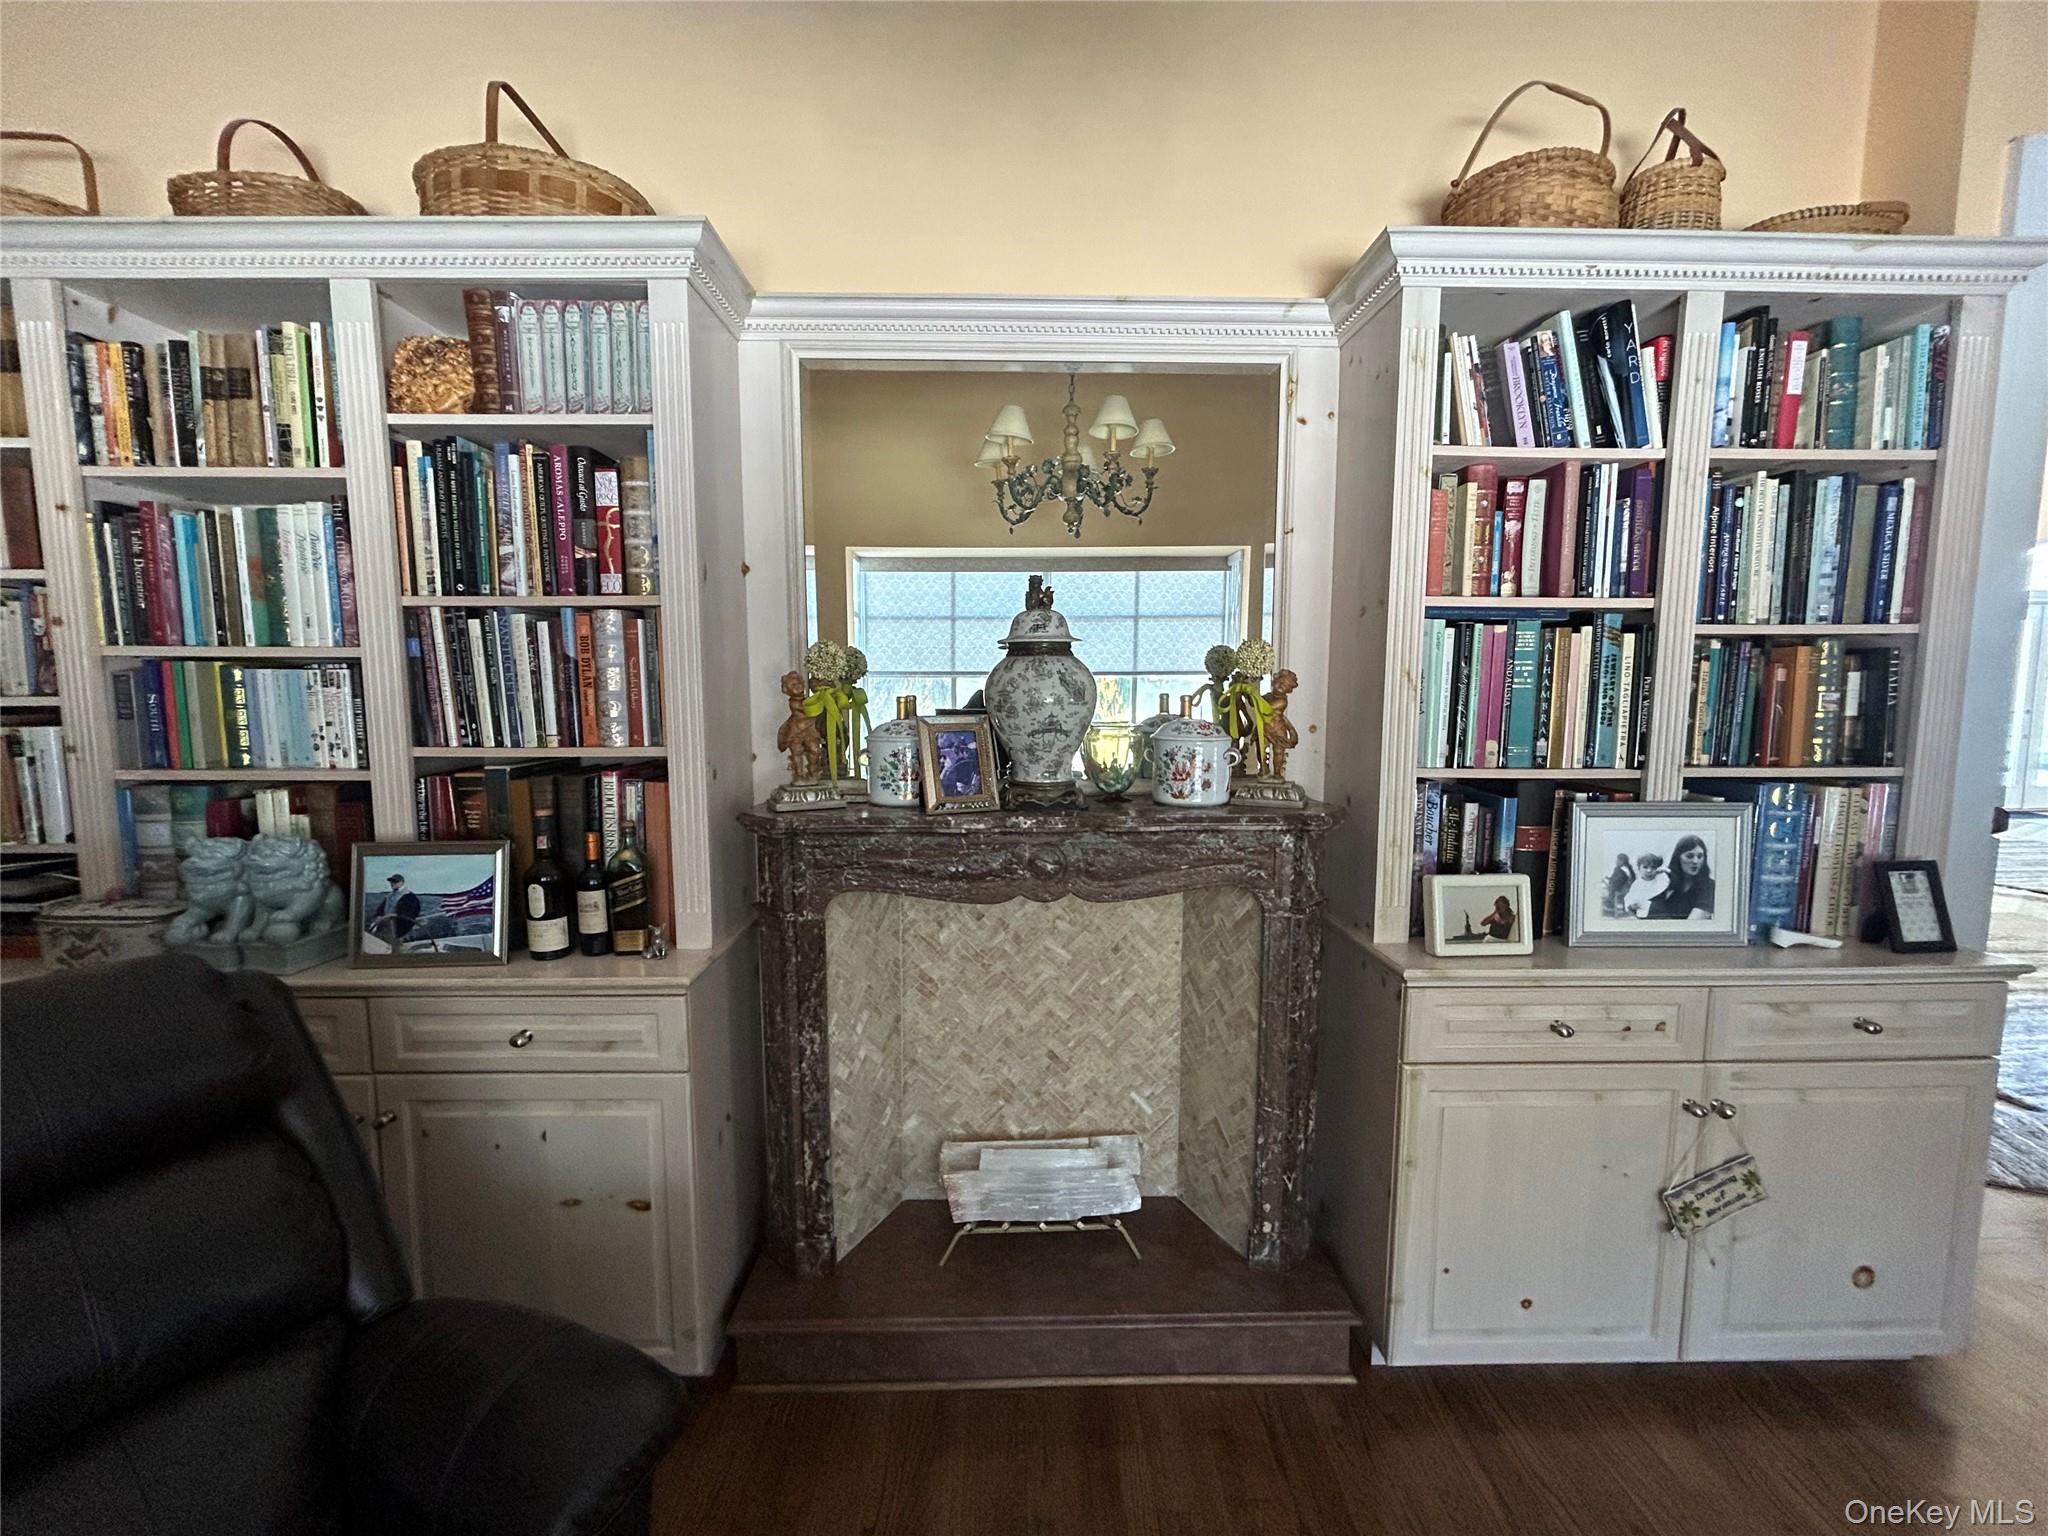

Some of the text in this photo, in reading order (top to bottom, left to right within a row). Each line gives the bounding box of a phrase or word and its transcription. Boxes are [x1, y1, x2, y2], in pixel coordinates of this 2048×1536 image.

[1600, 316, 1610, 341] moretti
[1919, 343, 1927, 358] THE
[1753, 347, 1765, 404] ENGLISH ROSES
[1512, 376, 1528, 429] BROOKLYN
[536, 462, 544, 492] AMERICAN
[552, 454, 563, 495] AROMAS
[576, 456, 587, 483] Oaxaca
[332, 501, 342, 520] THE
[576, 490, 588, 512] Gusto
[556, 501, 566, 541] ALEPPO
[1707, 505, 1719, 573] Alpine Interiors
[129, 528, 143, 554] Table
[1879, 511, 1895, 580] MEXICAN SILVER
[578, 634, 589, 655] BOB
[1595, 617, 1603, 640] MARIO
[498, 614, 516, 697] NANTUCKET
[580, 656, 592, 689] DYLAN
[1607, 654, 1617, 692] JEWELRY
[1503, 657, 1514, 707] ANDALUSIA
[1541, 642, 1554, 735] ALHAMBRA
[1618, 655, 1632, 747] LINO TAGLIAPIETRA
[1700, 671, 1709, 697] Italian
[1885, 658, 1900, 706] ITALIA
[1599, 702, 1607, 725] 1950s
[1640, 699, 1650, 734] VENEZIANE
[1422, 799, 1439, 846] Boucher
[1445, 805, 1460, 864] Al-Andalus
